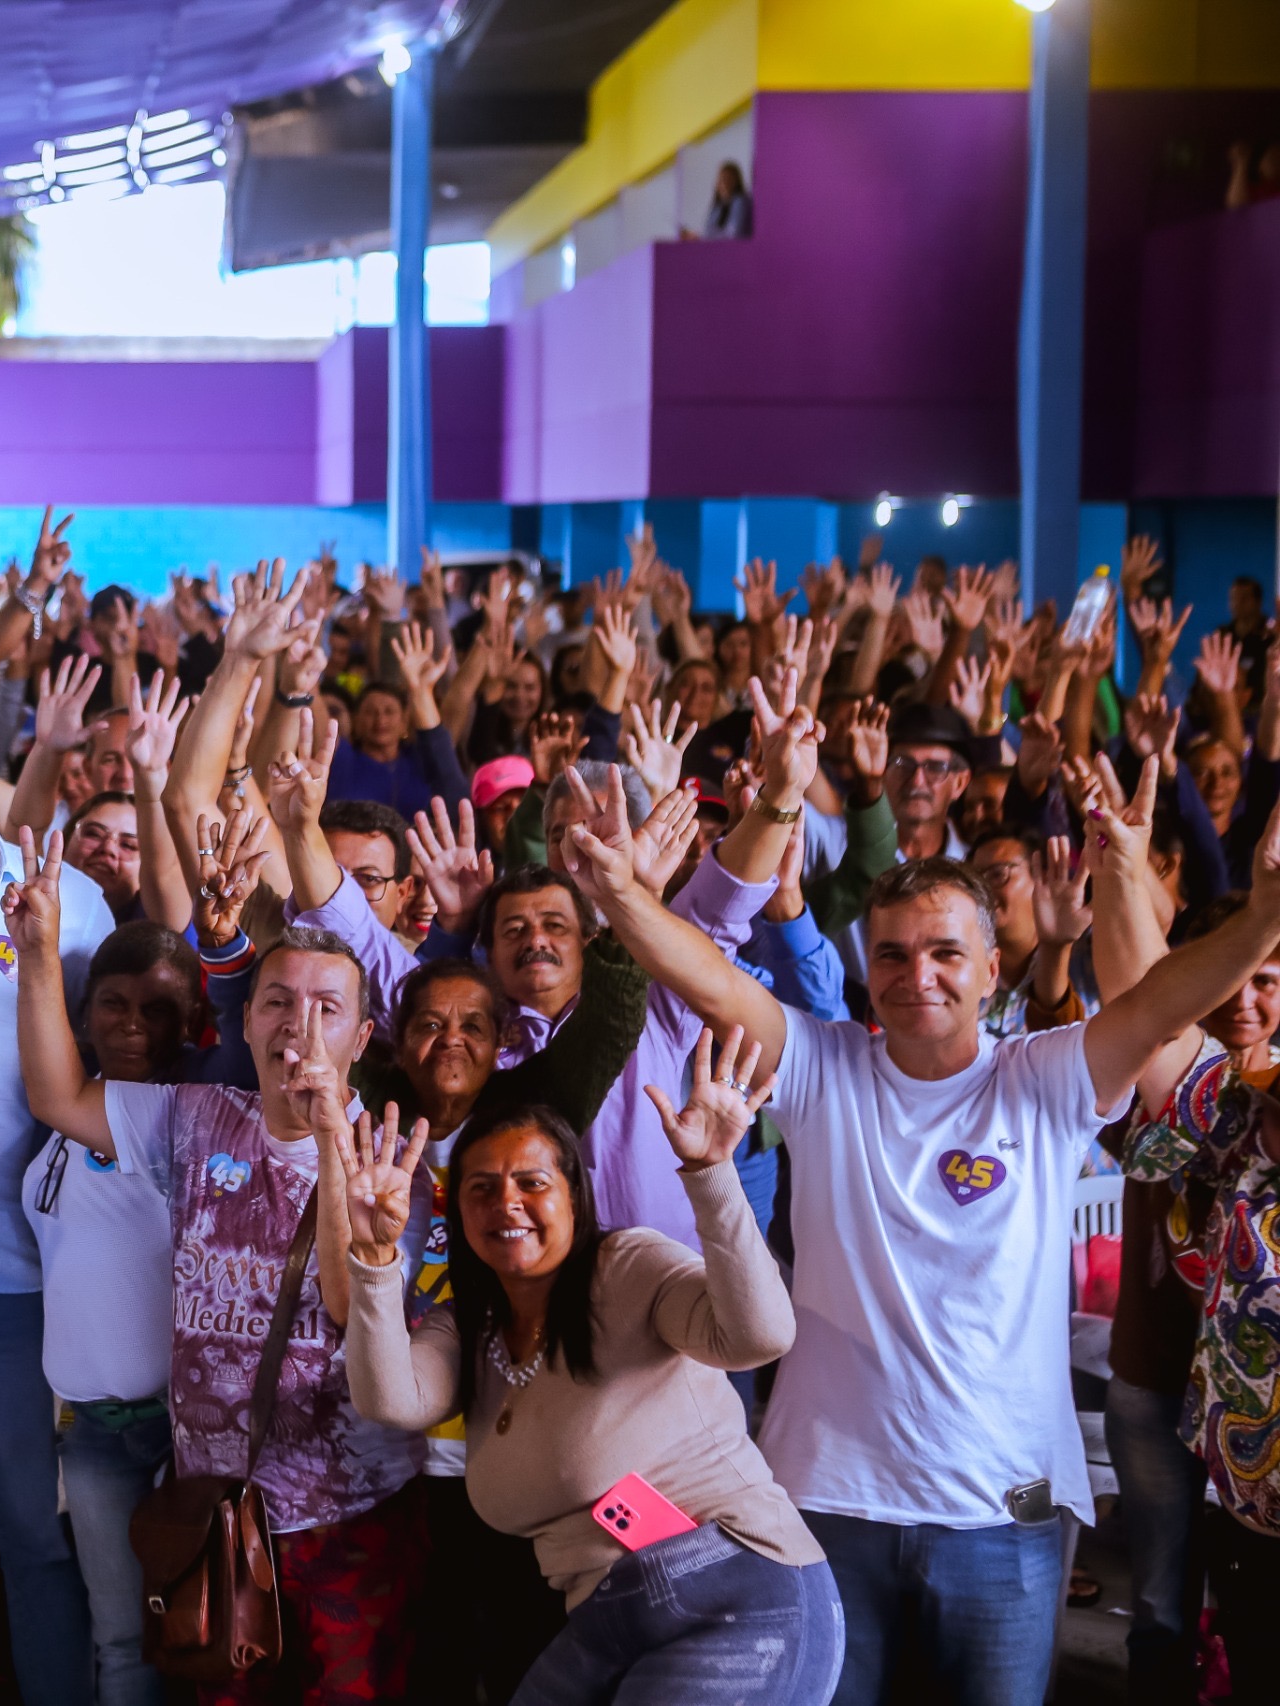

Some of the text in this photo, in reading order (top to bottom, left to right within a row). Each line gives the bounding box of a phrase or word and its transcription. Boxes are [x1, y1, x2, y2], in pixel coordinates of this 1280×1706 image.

[210, 1161, 246, 1193] 45
[946, 1155, 995, 1189] 45
[425, 1226, 447, 1248] 45
[176, 1294, 319, 1340] Medieal
